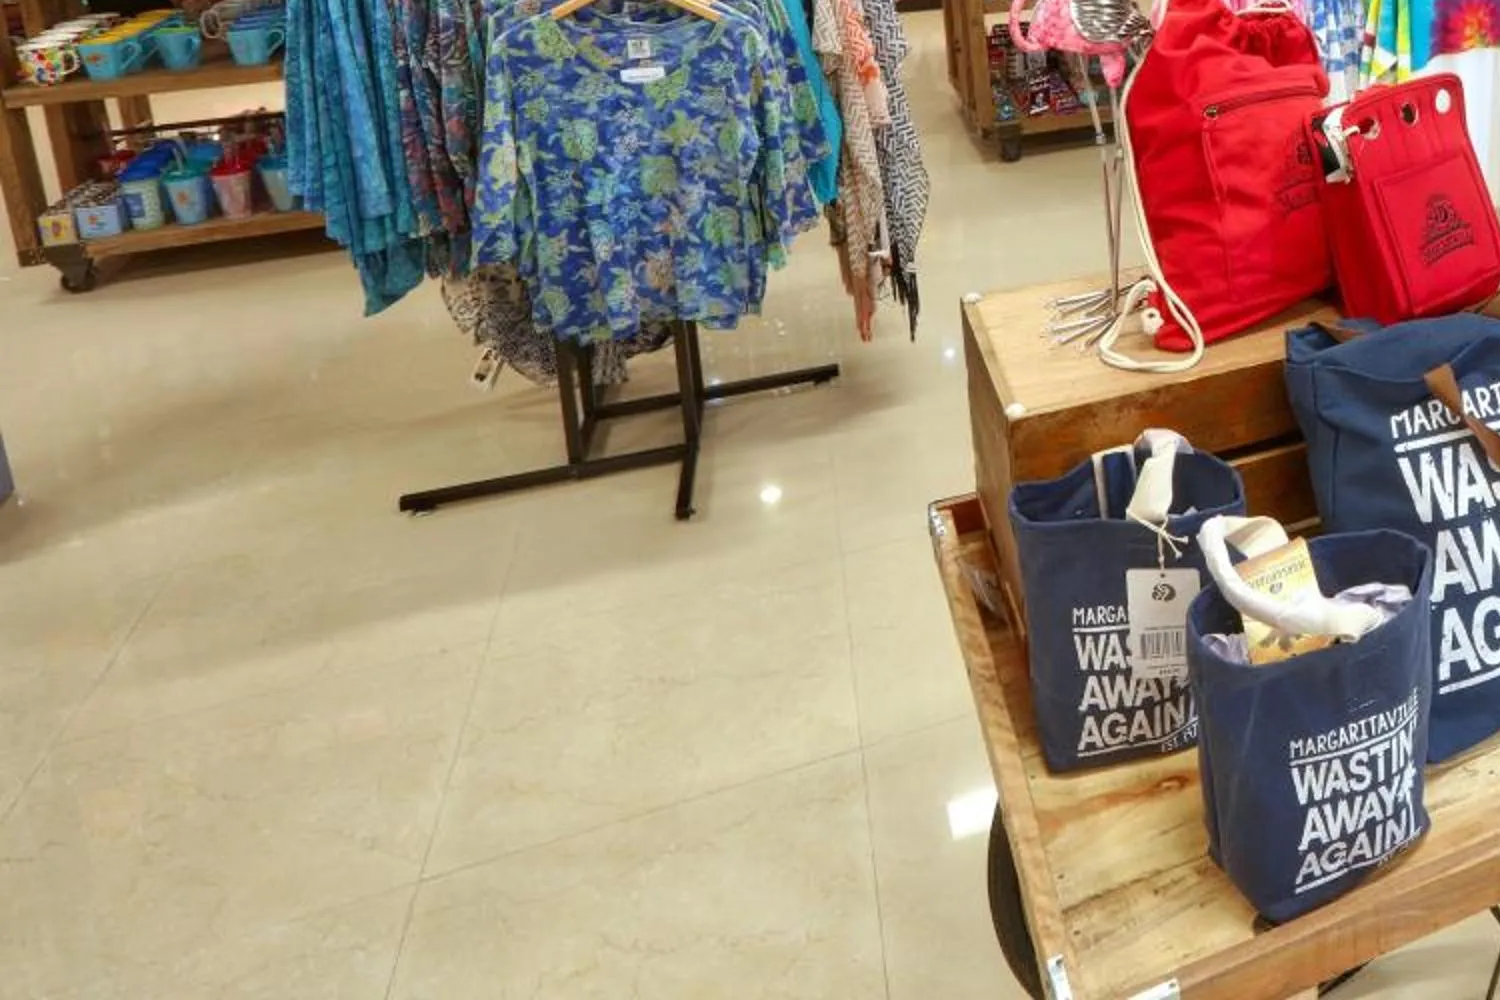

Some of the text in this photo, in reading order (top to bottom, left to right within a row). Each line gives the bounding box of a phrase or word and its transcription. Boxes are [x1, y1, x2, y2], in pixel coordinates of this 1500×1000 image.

[1077, 695, 1187, 751] AGAIN
[1295, 806, 1408, 886] AGAIN
[1297, 773, 1401, 852] AWAY
